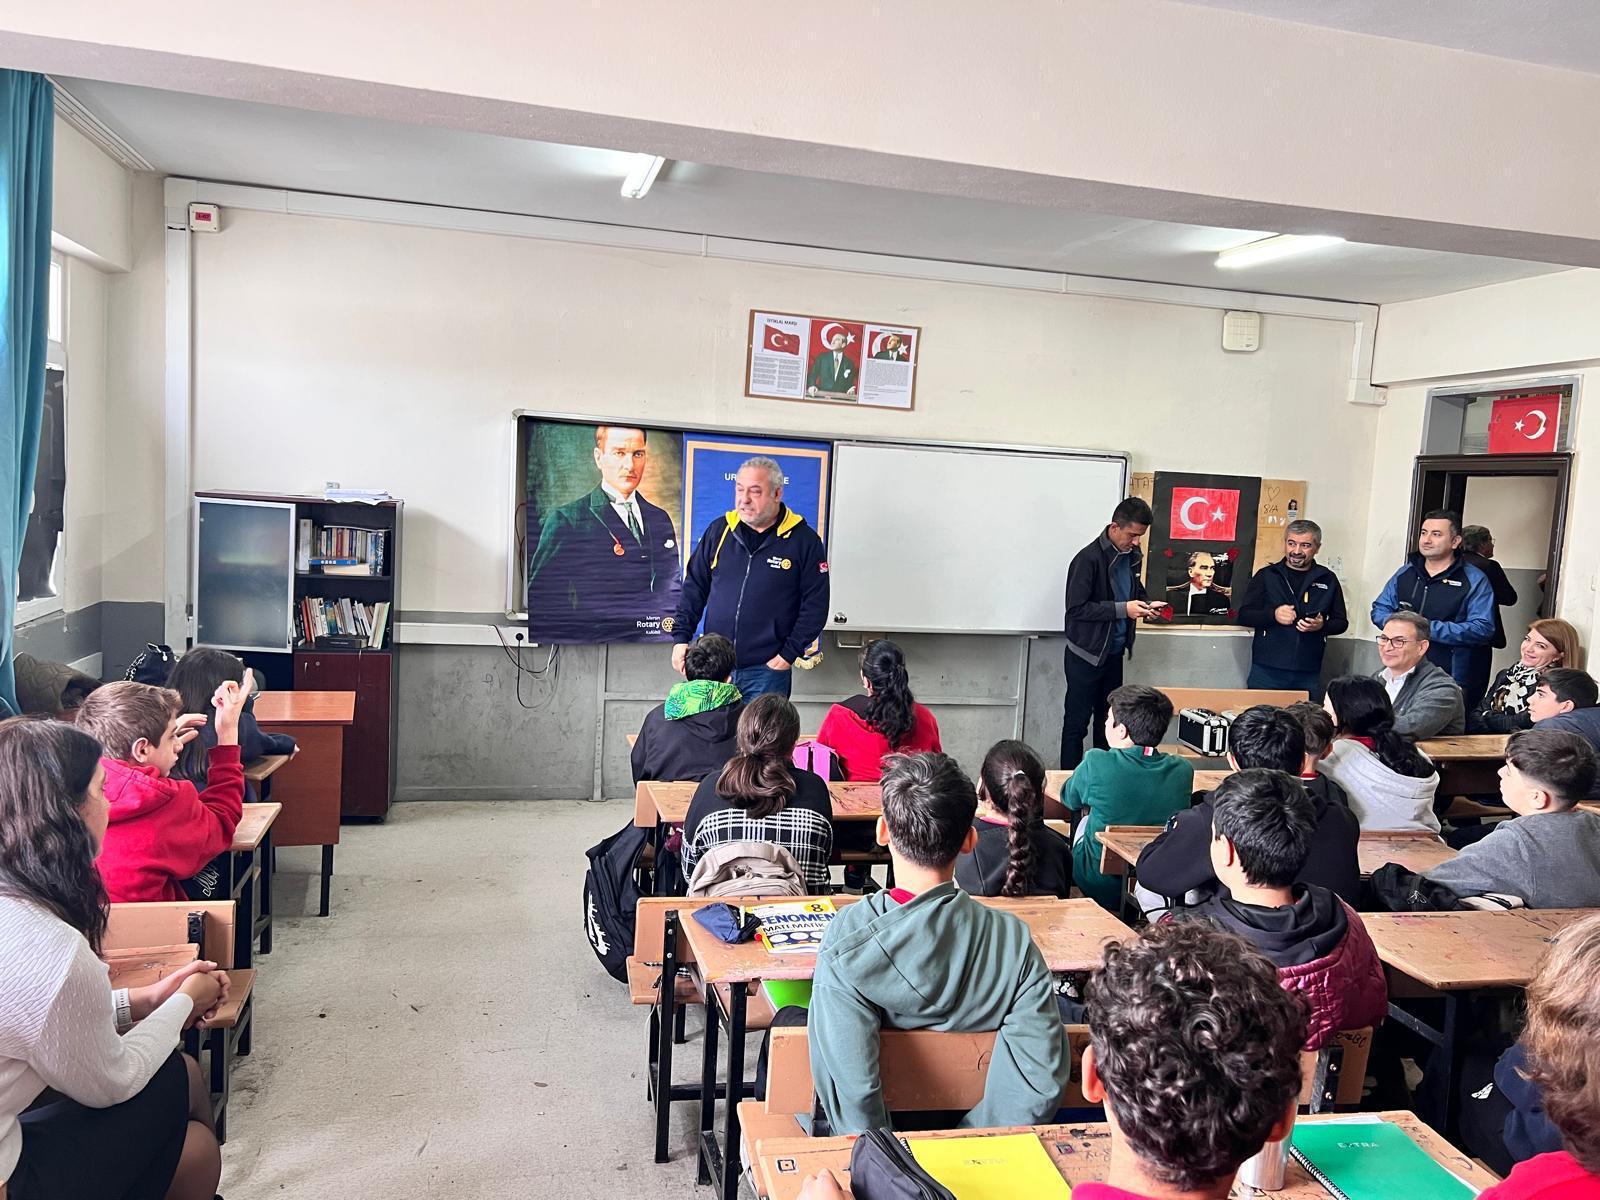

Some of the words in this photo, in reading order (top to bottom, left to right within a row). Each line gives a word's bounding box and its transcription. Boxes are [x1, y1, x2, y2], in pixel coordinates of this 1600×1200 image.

[636, 620, 661, 629] Rotary
[811, 903, 824, 912] 8
[760, 912, 835, 926] FENOMEN
